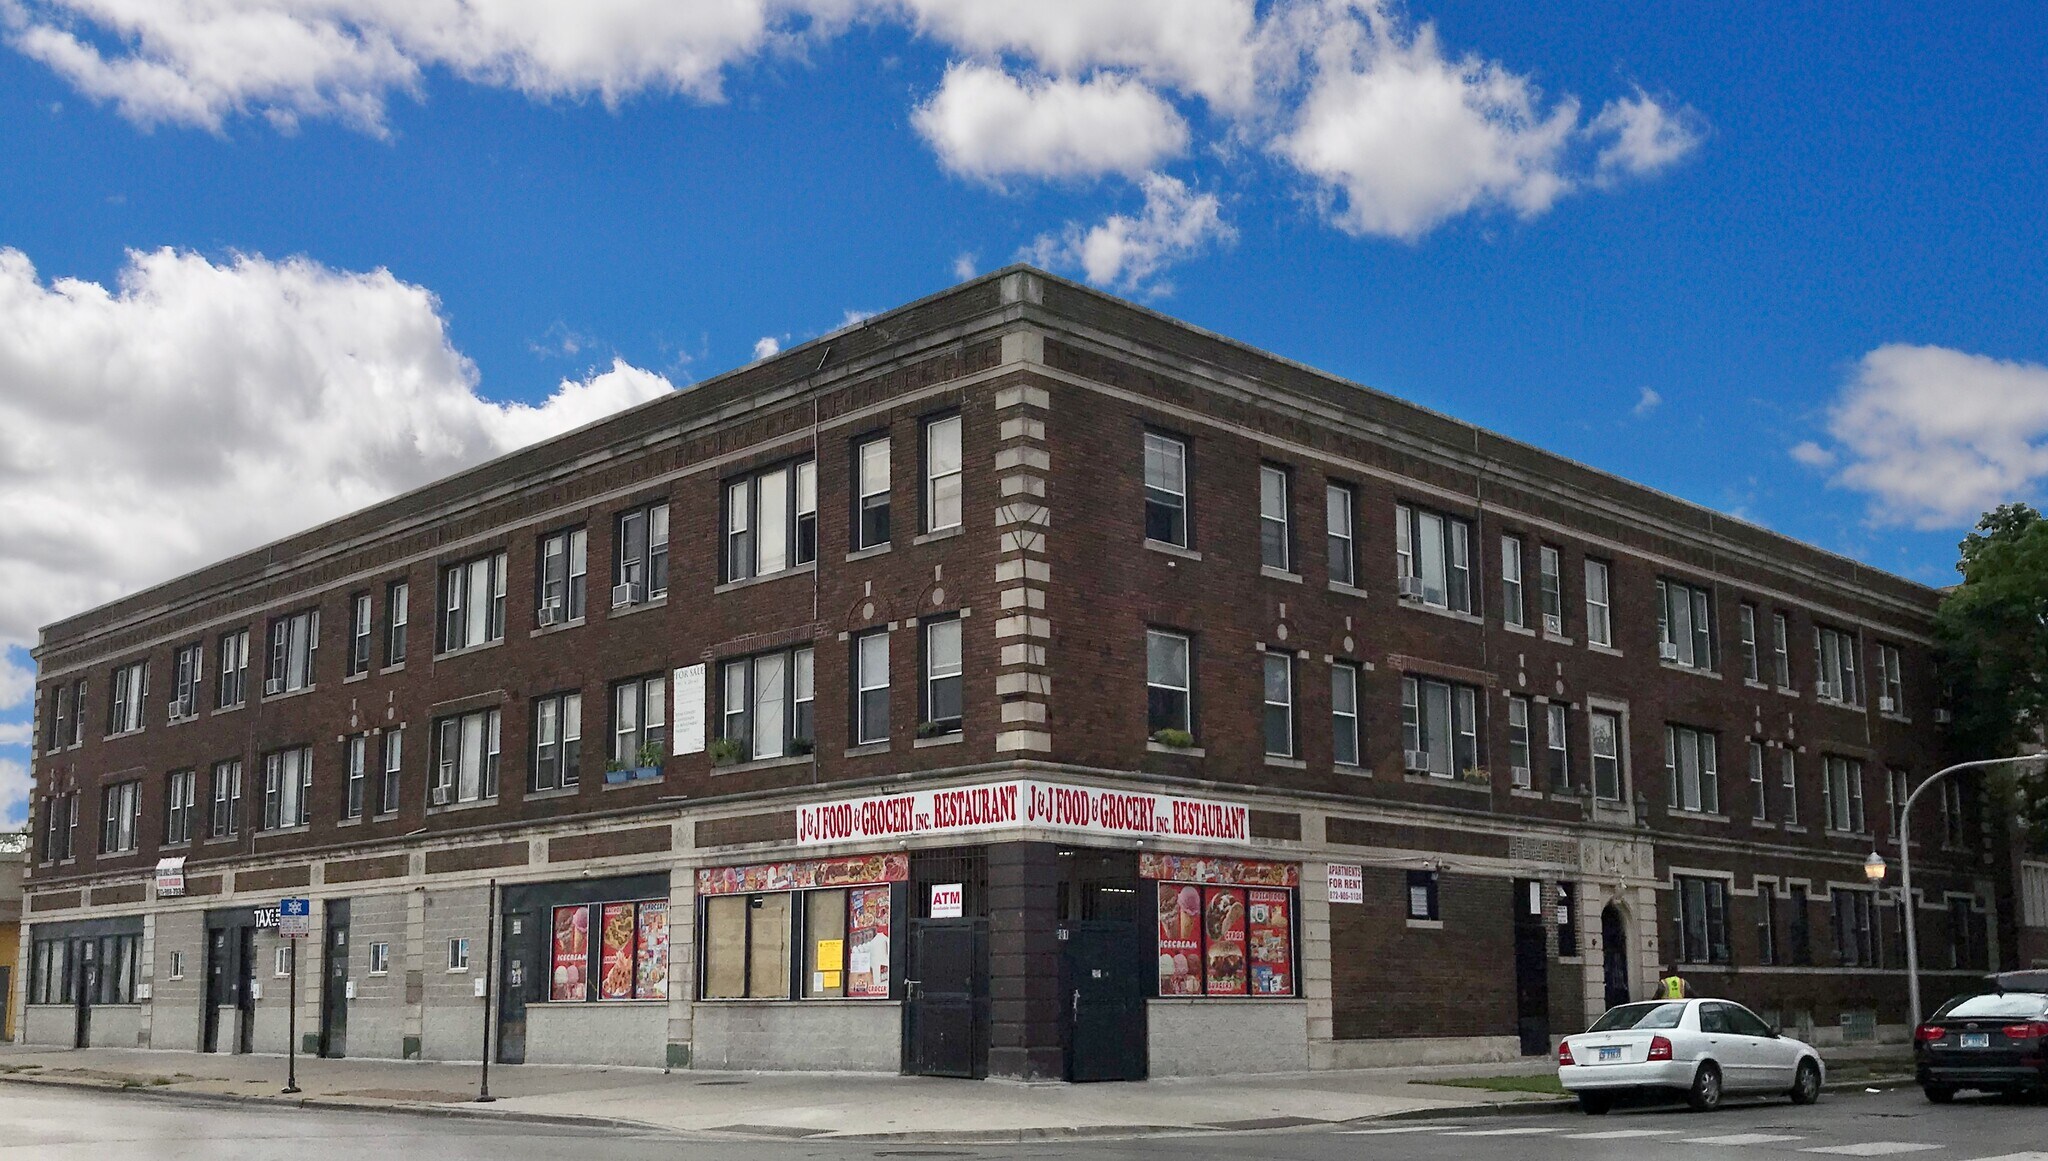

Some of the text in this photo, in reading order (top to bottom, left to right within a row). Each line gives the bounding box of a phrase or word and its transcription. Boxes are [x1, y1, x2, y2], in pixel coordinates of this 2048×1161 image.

[822, 803, 853, 840] FOOD
[861, 796, 915, 836] GROCERY
[933, 784, 1018, 829] RESTAURANT
[1055, 788, 1090, 826] FOOD
[1100, 792, 1155, 832] GROCERY
[1172, 800, 1246, 840] RESTAURANT
[1329, 865, 1361, 877] APARTMENTS
[1329, 878, 1361, 890] FOR RENT
[933, 891, 960, 906] ATM
